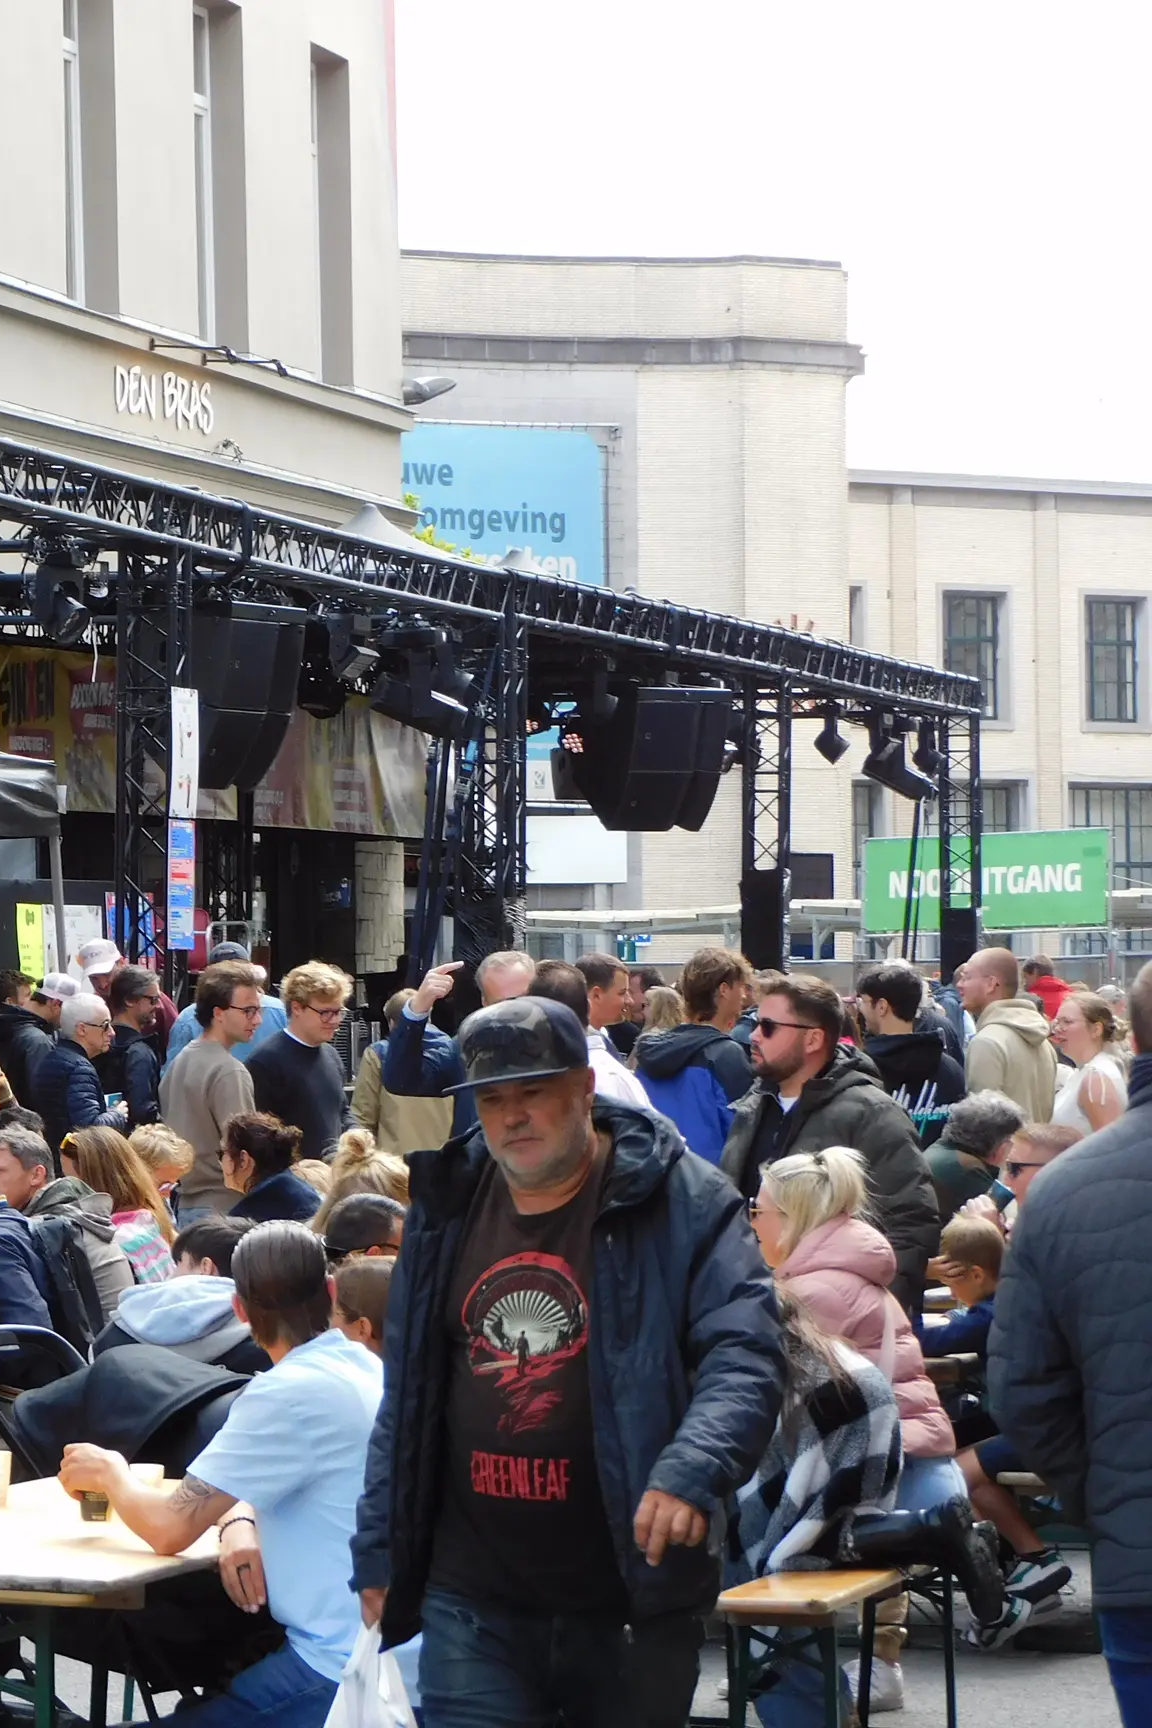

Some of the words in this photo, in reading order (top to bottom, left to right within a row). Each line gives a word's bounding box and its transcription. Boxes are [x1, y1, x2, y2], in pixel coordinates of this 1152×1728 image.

[114, 364, 156, 420] DEN
[163, 371, 214, 435] BRAS
[471, 1450, 570, 1500] GREENLEAF
